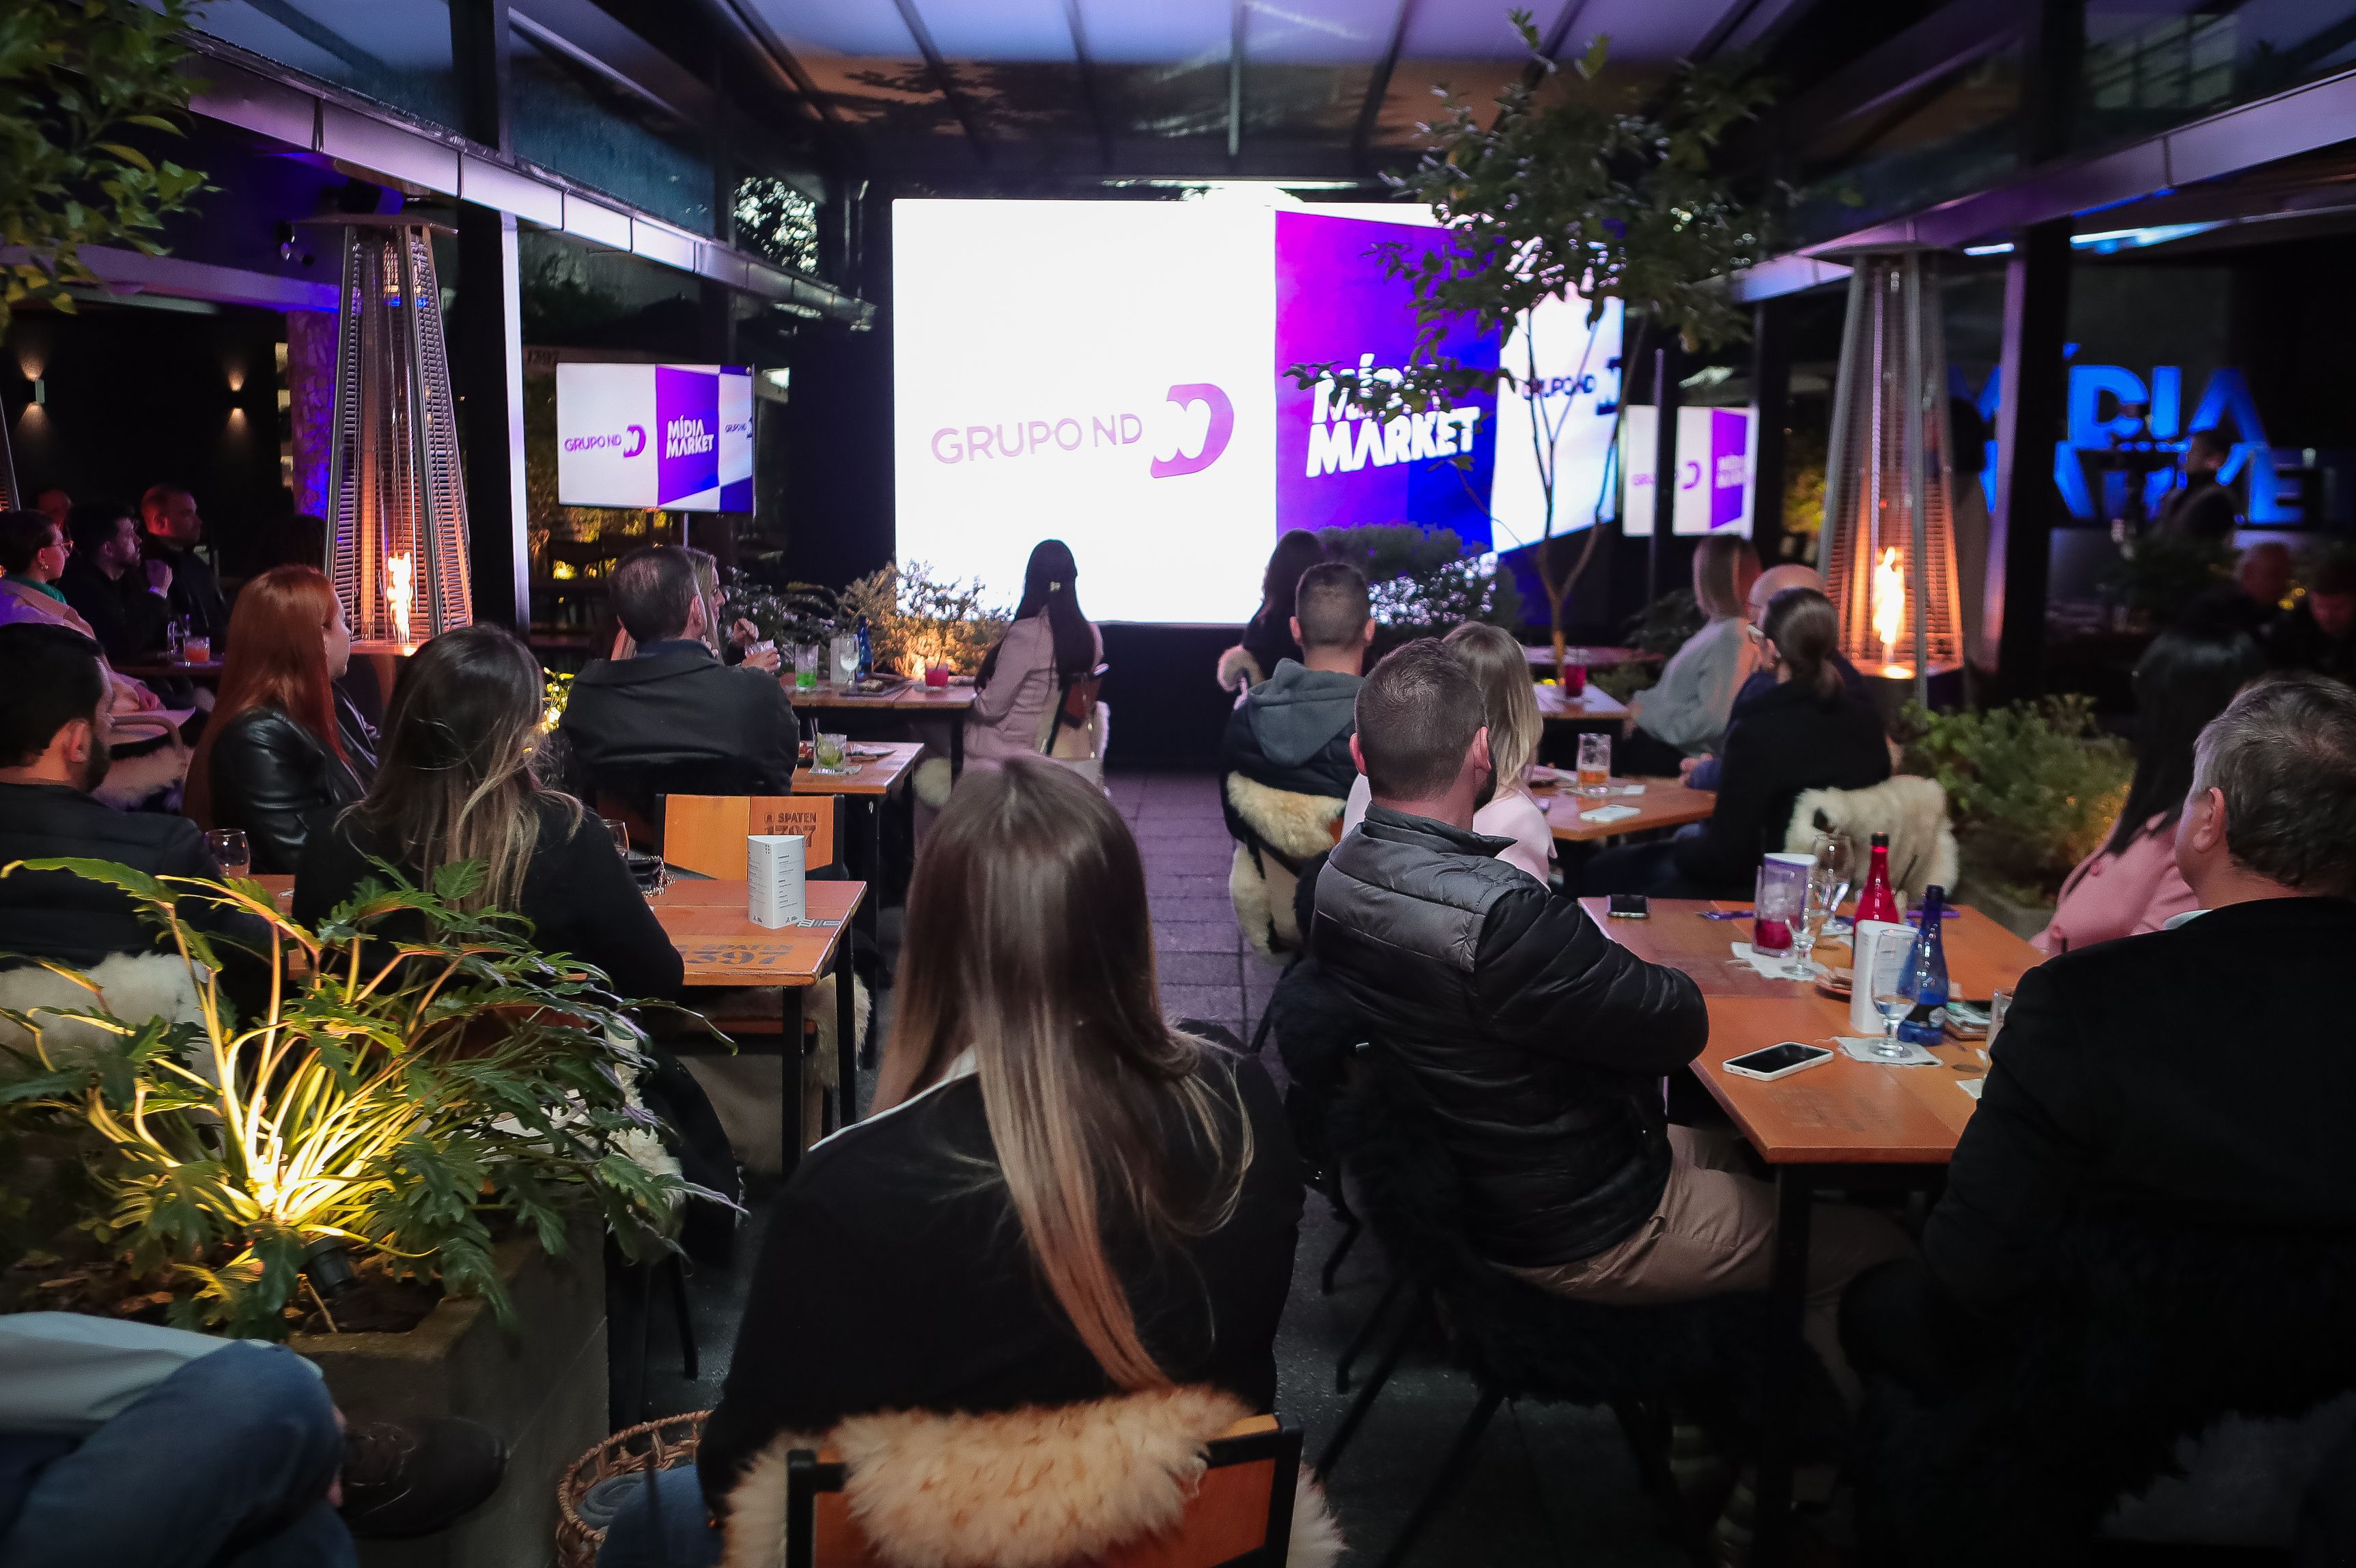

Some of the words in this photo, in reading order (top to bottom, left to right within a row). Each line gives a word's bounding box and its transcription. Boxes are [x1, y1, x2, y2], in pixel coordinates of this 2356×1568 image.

[1948, 343, 2271, 451] DIA
[667, 415, 705, 440] MÍDIA
[931, 417, 1083, 464] GRUPO
[1093, 412, 1142, 448] ND
[564, 434, 606, 452] GRUPO
[607, 434, 622, 448] ND
[666, 434, 714, 460] MARKET
[1306, 406, 1481, 478] MARKET
[778, 812, 817, 823] SPATEN
[679, 950, 789, 965] 397
